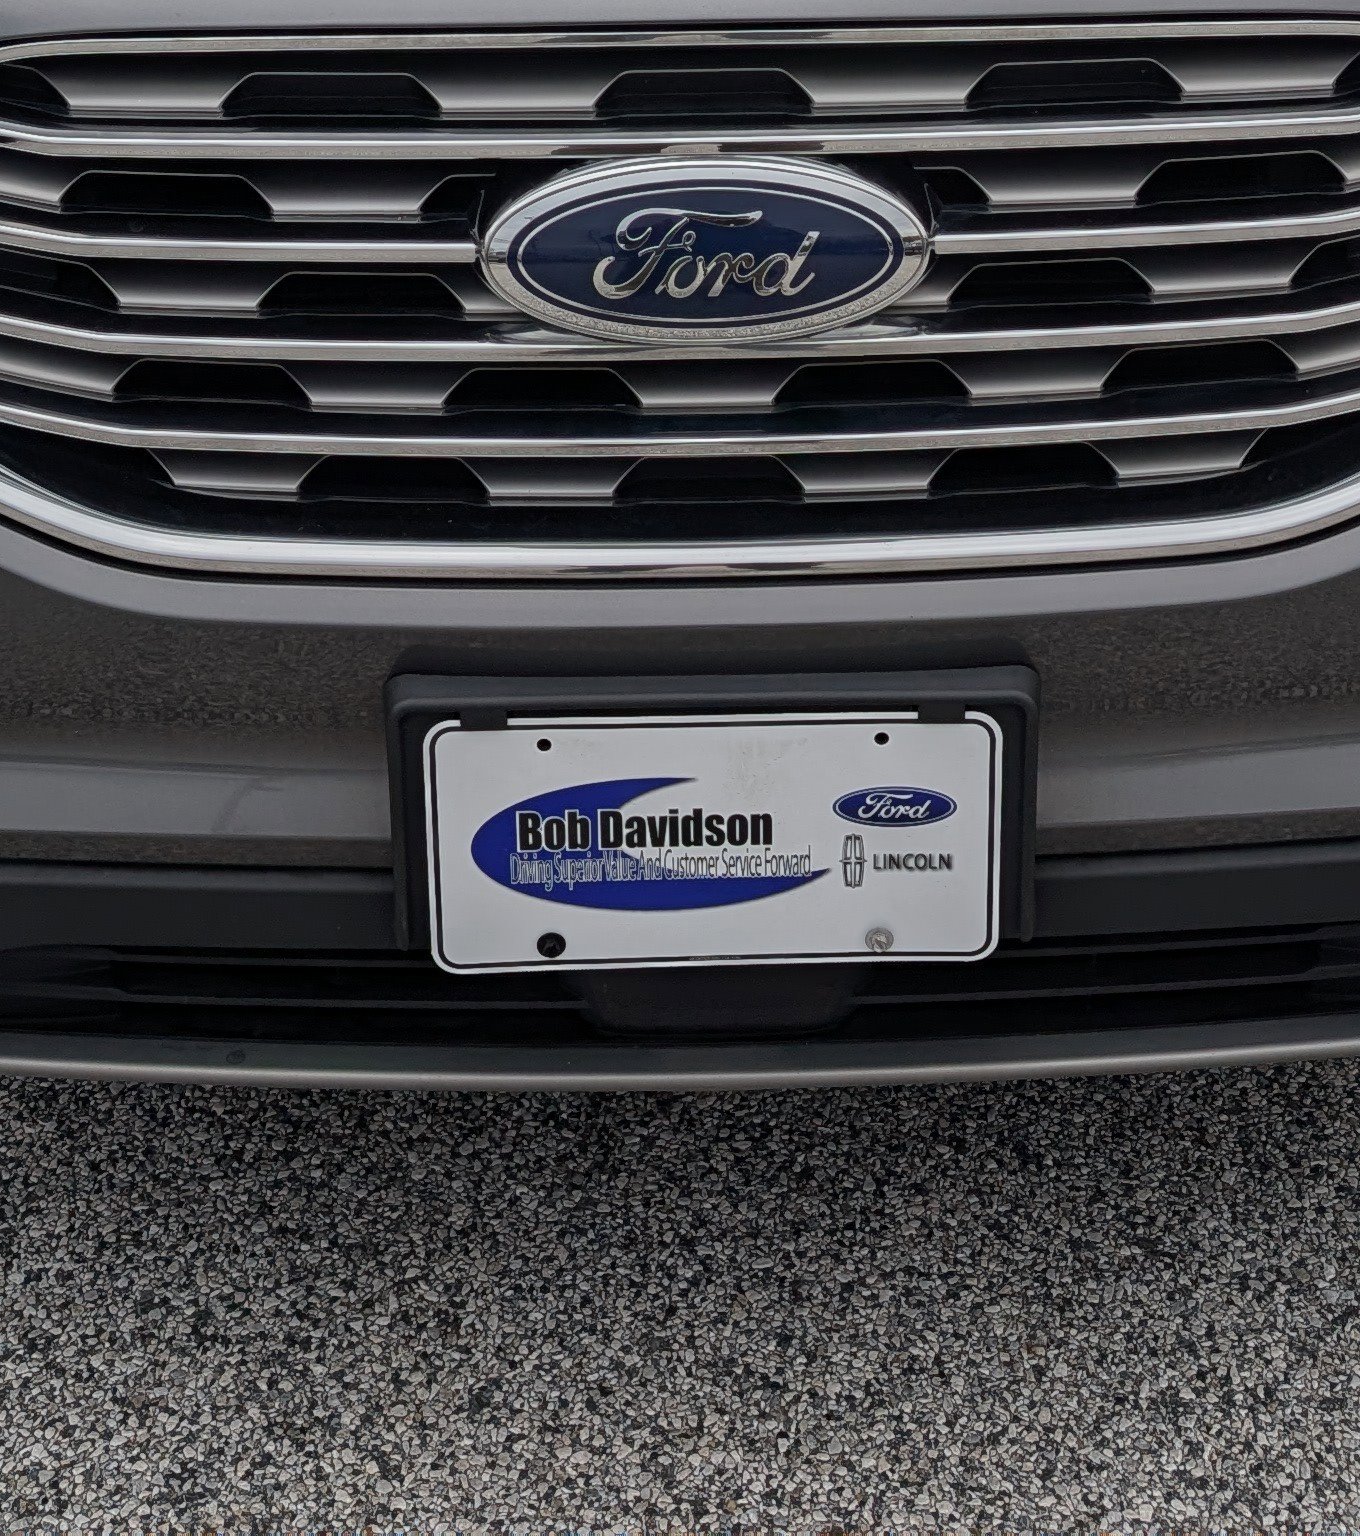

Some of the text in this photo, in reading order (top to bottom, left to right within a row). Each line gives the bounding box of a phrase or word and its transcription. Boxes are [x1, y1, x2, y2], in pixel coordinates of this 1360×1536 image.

[591, 206, 822, 300] Ford
[858, 792, 931, 819] Ford
[517, 808, 773, 852] Bob Davidson
[510, 844, 812, 892] Driving Superior Value And Customer Service Forward
[873, 853, 953, 870] LINCOLN
